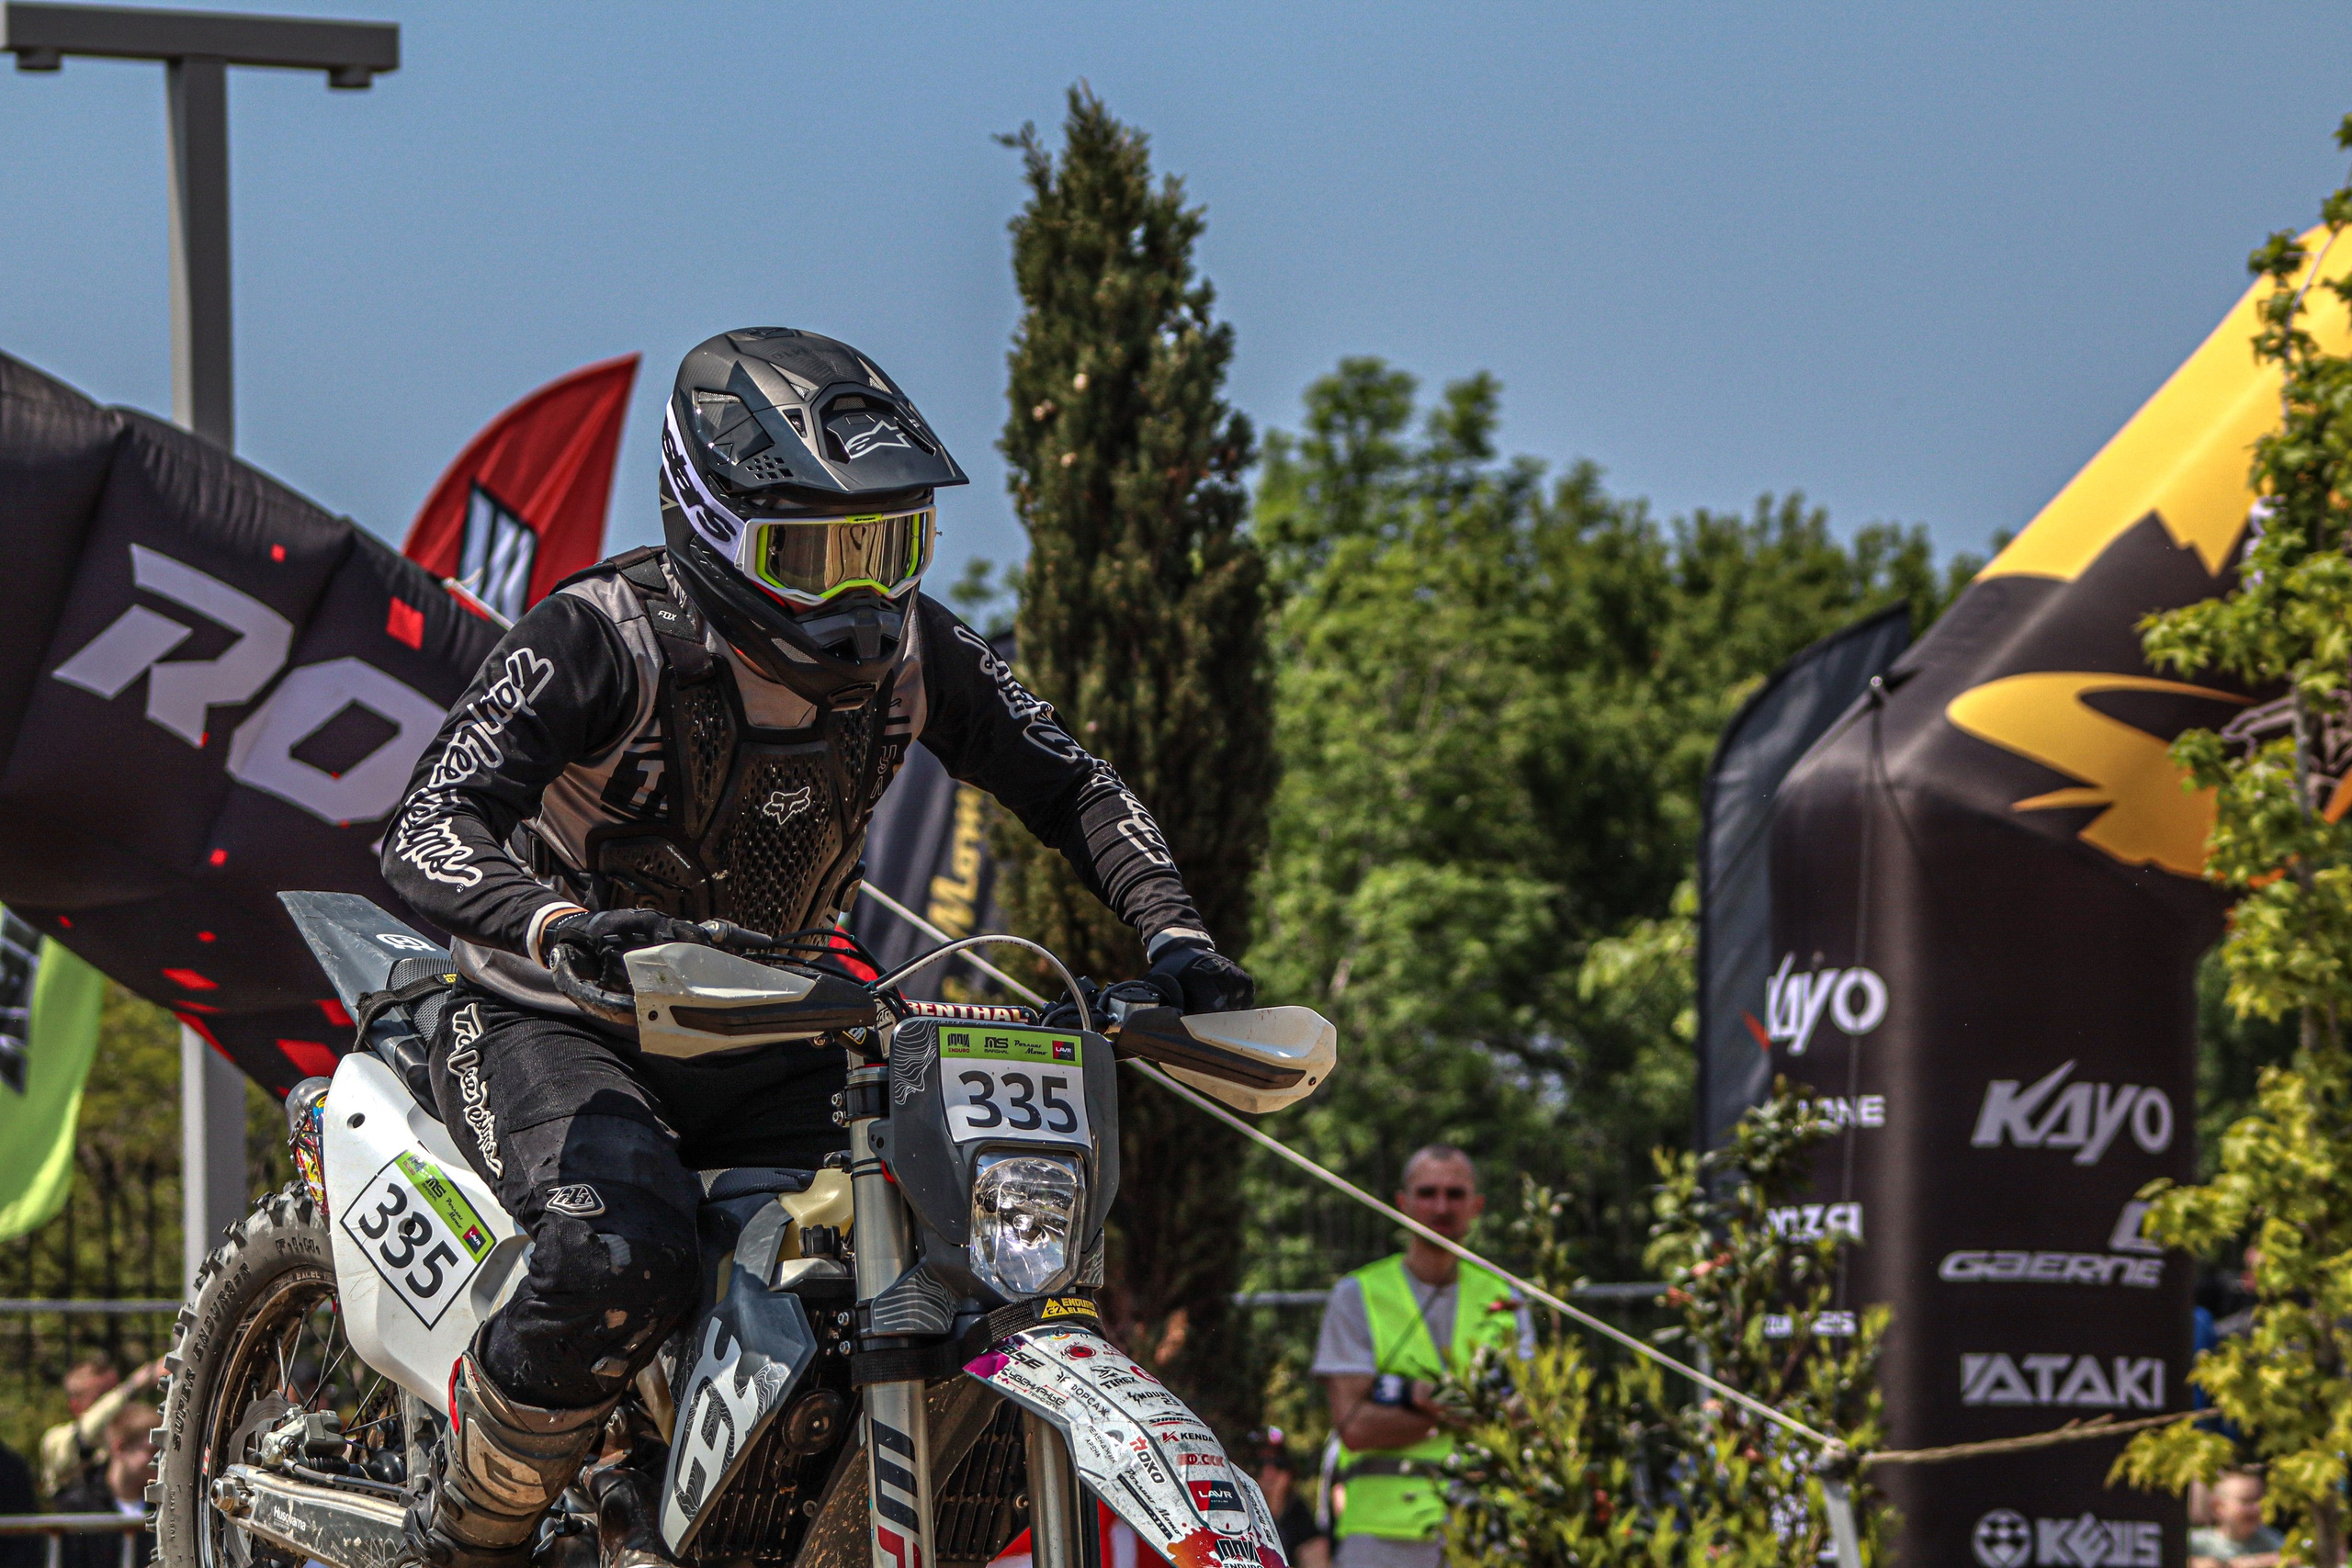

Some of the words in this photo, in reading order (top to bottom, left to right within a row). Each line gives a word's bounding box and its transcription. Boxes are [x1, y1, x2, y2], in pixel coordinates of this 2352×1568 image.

[658, 610, 677, 622] FOX
[467, 648, 555, 736] Troy
[427, 719, 504, 789] Lee
[904, 1001, 1029, 1023] RENTHAL
[958, 1070, 1078, 1134] 335
[358, 1182, 459, 1298] 335
[172, 1366, 196, 1452] SUPER
[1070, 1383, 1111, 1417] ДОРСАЖ
[1181, 1432, 1215, 1443] KENDA
[1129, 1436, 1165, 1484] ROXO
[1198, 1490, 1233, 1499] LAVR
[273, 1505, 307, 1532] Husqvarna
